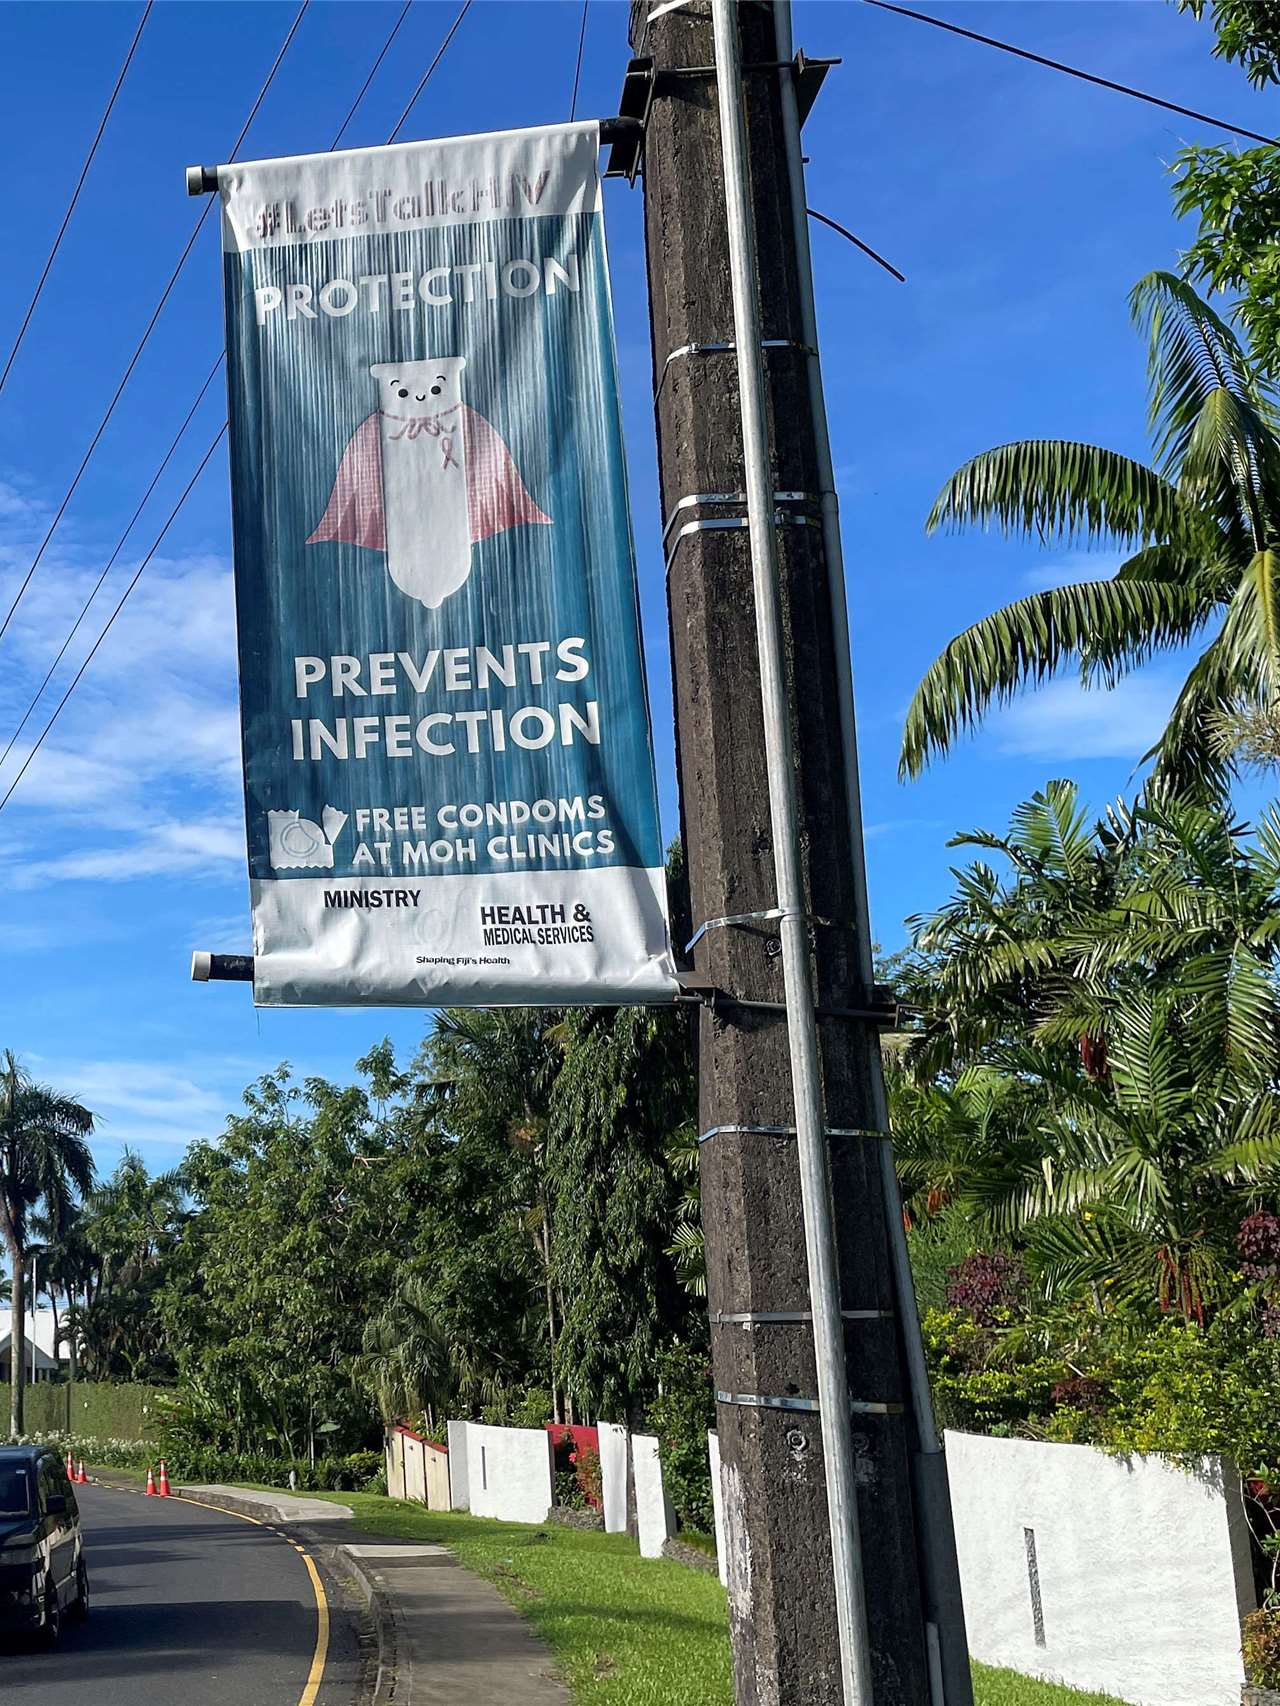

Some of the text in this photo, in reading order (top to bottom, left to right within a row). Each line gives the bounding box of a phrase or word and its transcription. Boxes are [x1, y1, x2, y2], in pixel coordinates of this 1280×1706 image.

[255, 254, 580, 326] PROTECTION
[294, 636, 591, 698] PREVENTS
[291, 701, 601, 761] INFECTION
[355, 794, 607, 832] FREE CONDOMS
[352, 829, 615, 866] AT MOH CLINICS
[323, 888, 421, 910] MINISTRY
[480, 903, 592, 926] HEALTH &
[483, 925, 595, 947] MEDICAL SERVICES
[416, 956, 510, 967] Shaping Fiji's Health
